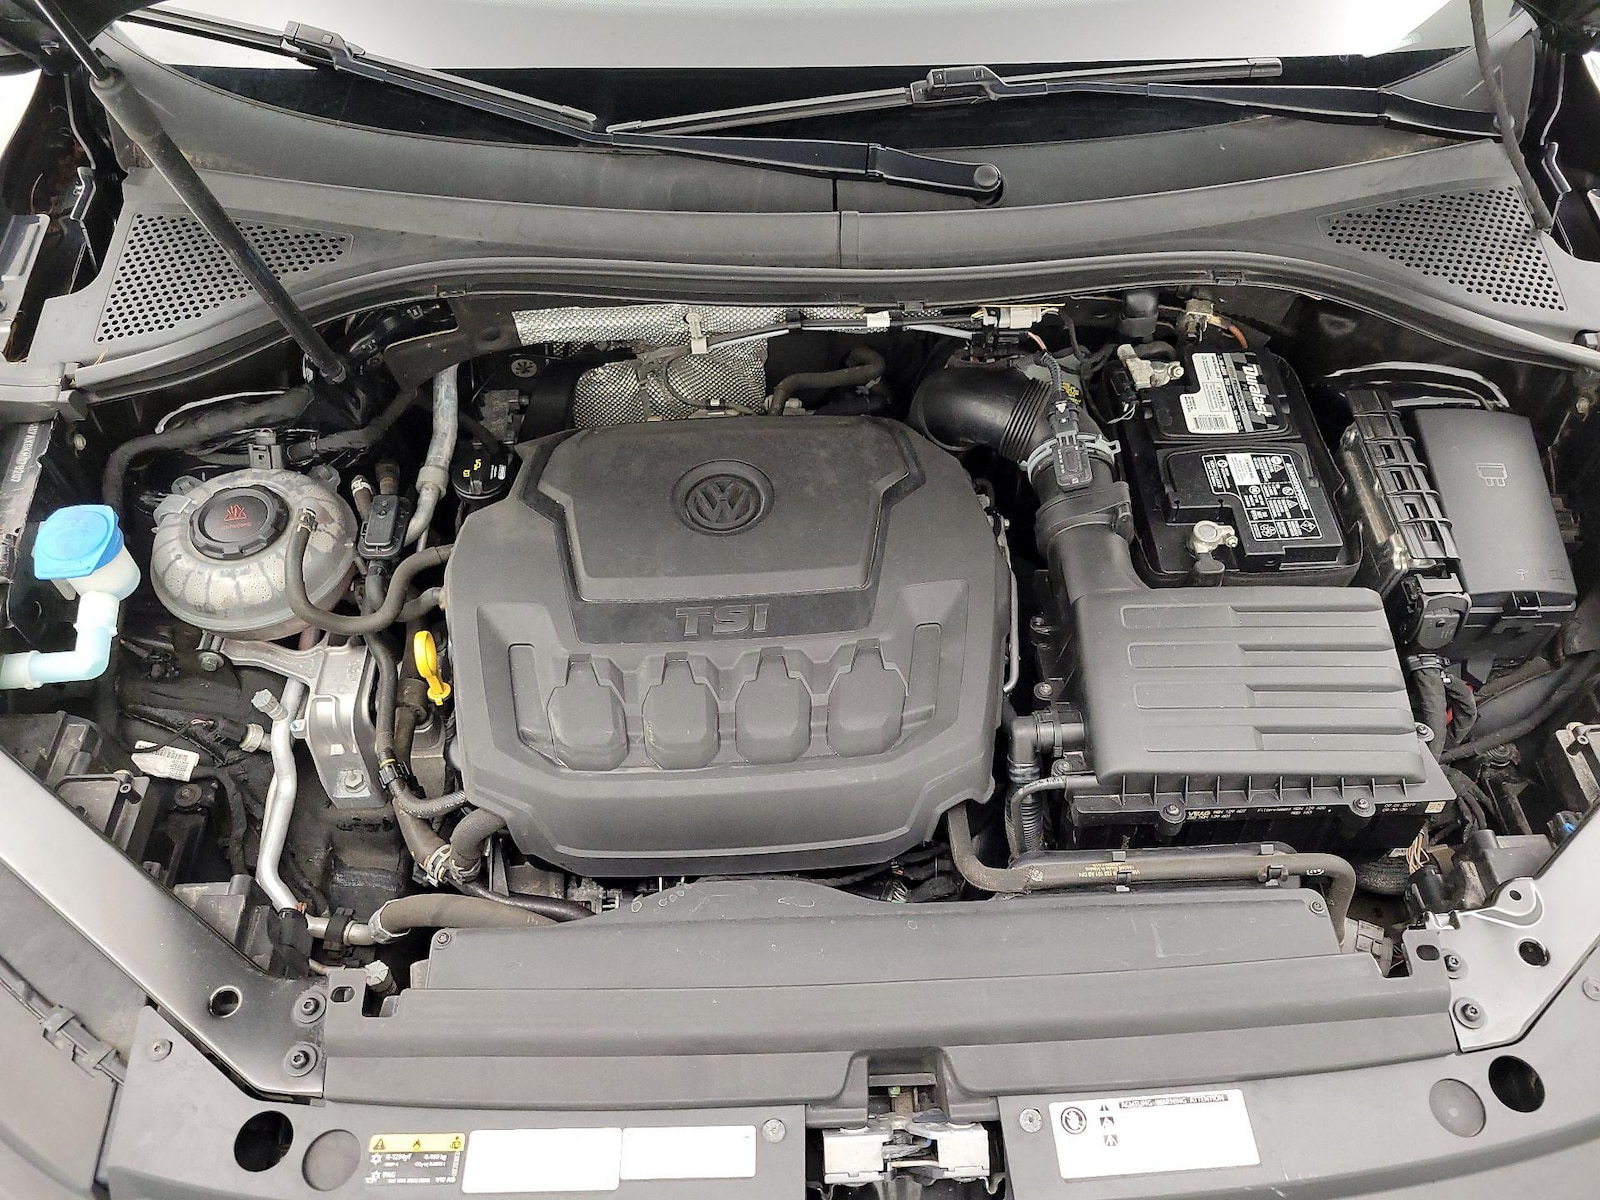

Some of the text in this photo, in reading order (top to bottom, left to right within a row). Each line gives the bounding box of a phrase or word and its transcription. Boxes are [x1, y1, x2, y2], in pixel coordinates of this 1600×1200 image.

[1242, 363, 1273, 418] Duralast
[687, 474, 763, 532] VW
[675, 603, 770, 636] TSI
[1121, 1094, 1224, 1108] ACHTUNG WARNING ATTENTION
[382, 1171, 396, 1179] PAG
